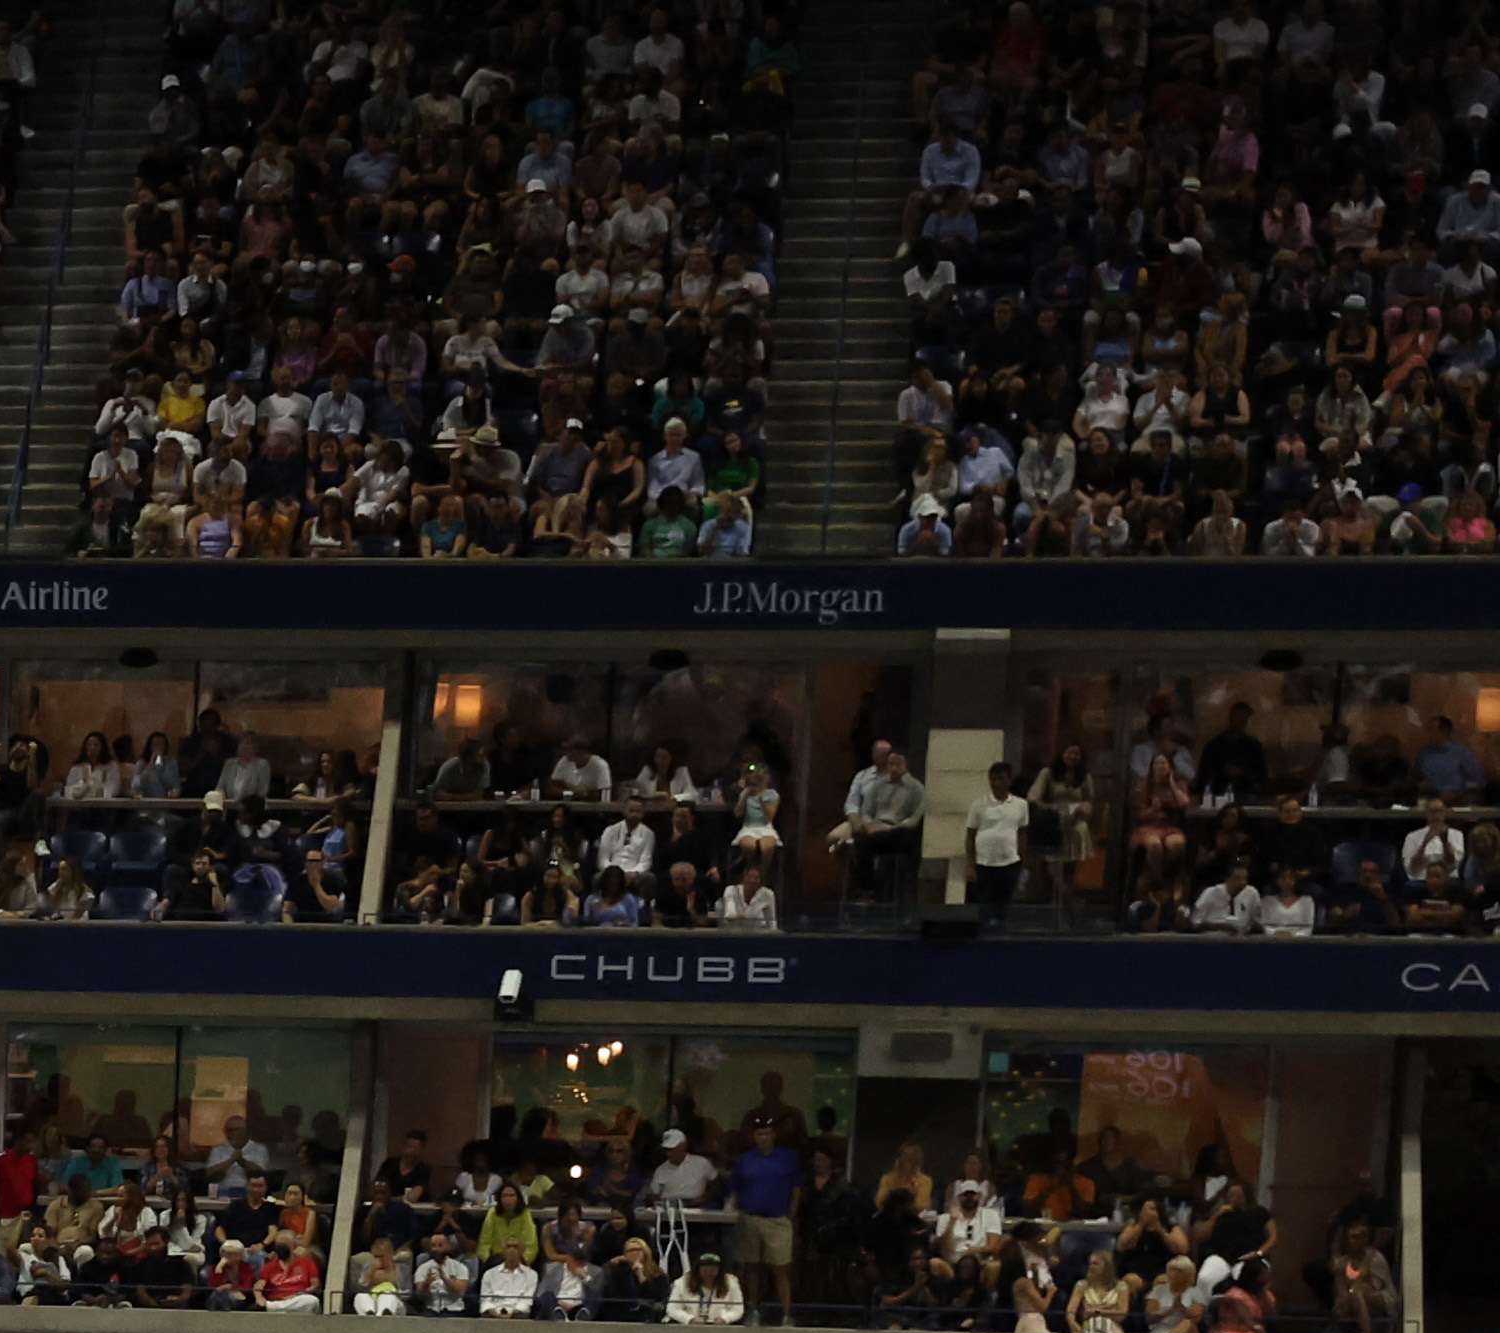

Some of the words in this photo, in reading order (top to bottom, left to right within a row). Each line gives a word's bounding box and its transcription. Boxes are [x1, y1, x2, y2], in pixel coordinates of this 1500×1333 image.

[1, 581, 108, 610] Airline
[694, 582, 882, 624] J.P.Morgan
[551, 955, 785, 982] CHUBB
